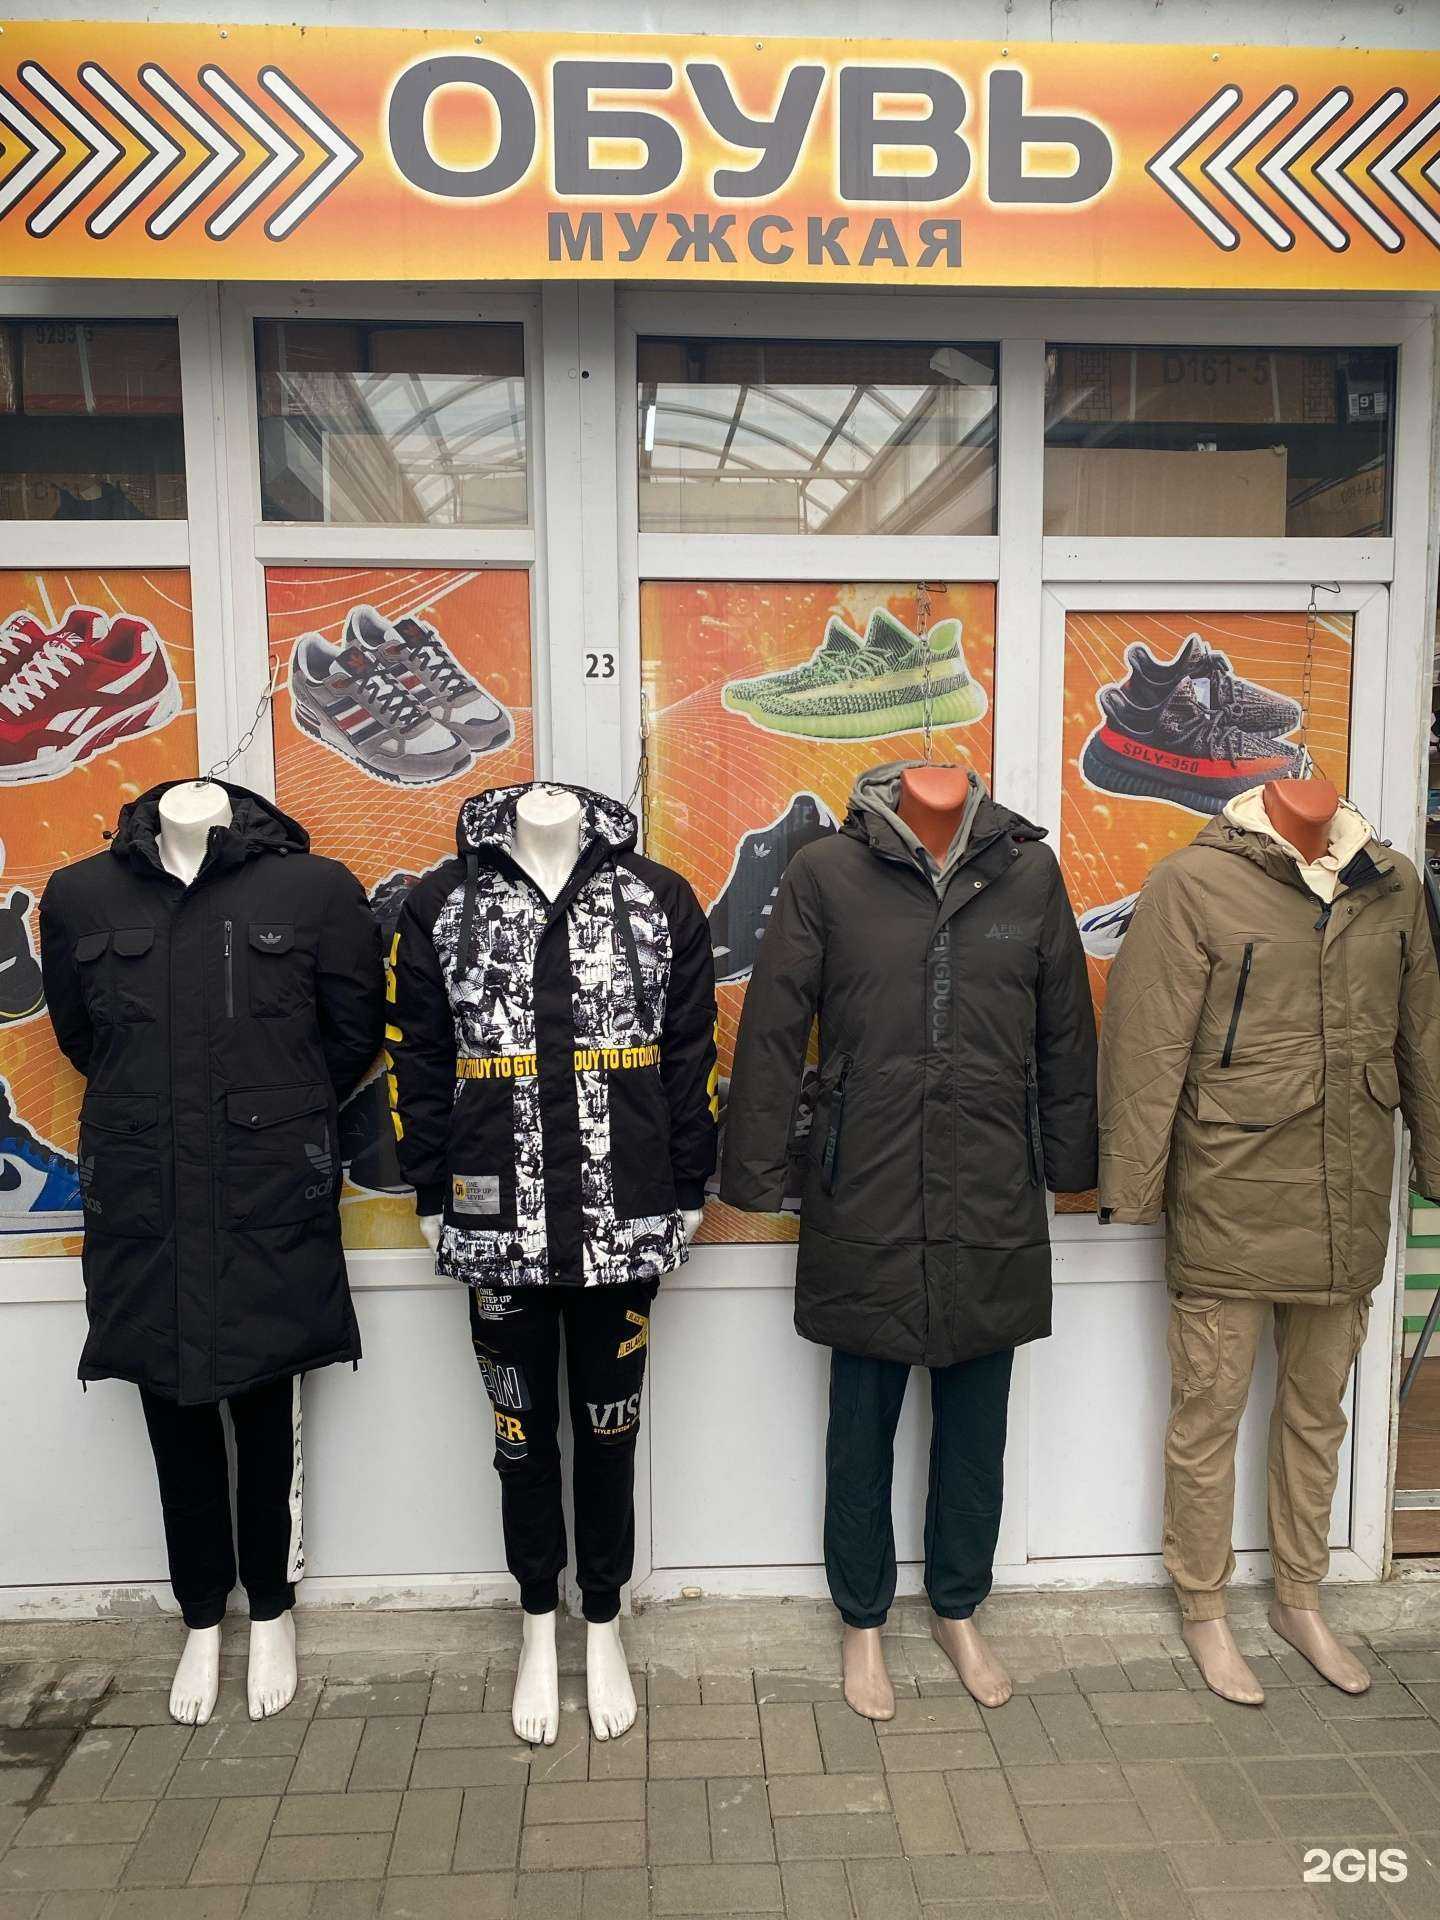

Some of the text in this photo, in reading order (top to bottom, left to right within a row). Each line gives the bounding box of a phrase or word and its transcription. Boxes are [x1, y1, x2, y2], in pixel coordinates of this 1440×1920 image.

[388, 55, 1113, 204] ОБУВЬ
[547, 212, 963, 268] МУЖСКАЯ
[586, 654, 615, 678] 23
[1122, 742, 1199, 773] SPLY-350
[493, 1057, 512, 1078] TO
[601, 1048, 620, 1070] TO
[479, 1287, 494, 1296] ONE
[481, 1295, 512, 1304] STEP UP
[483, 1303, 506, 1312] LEVEL
